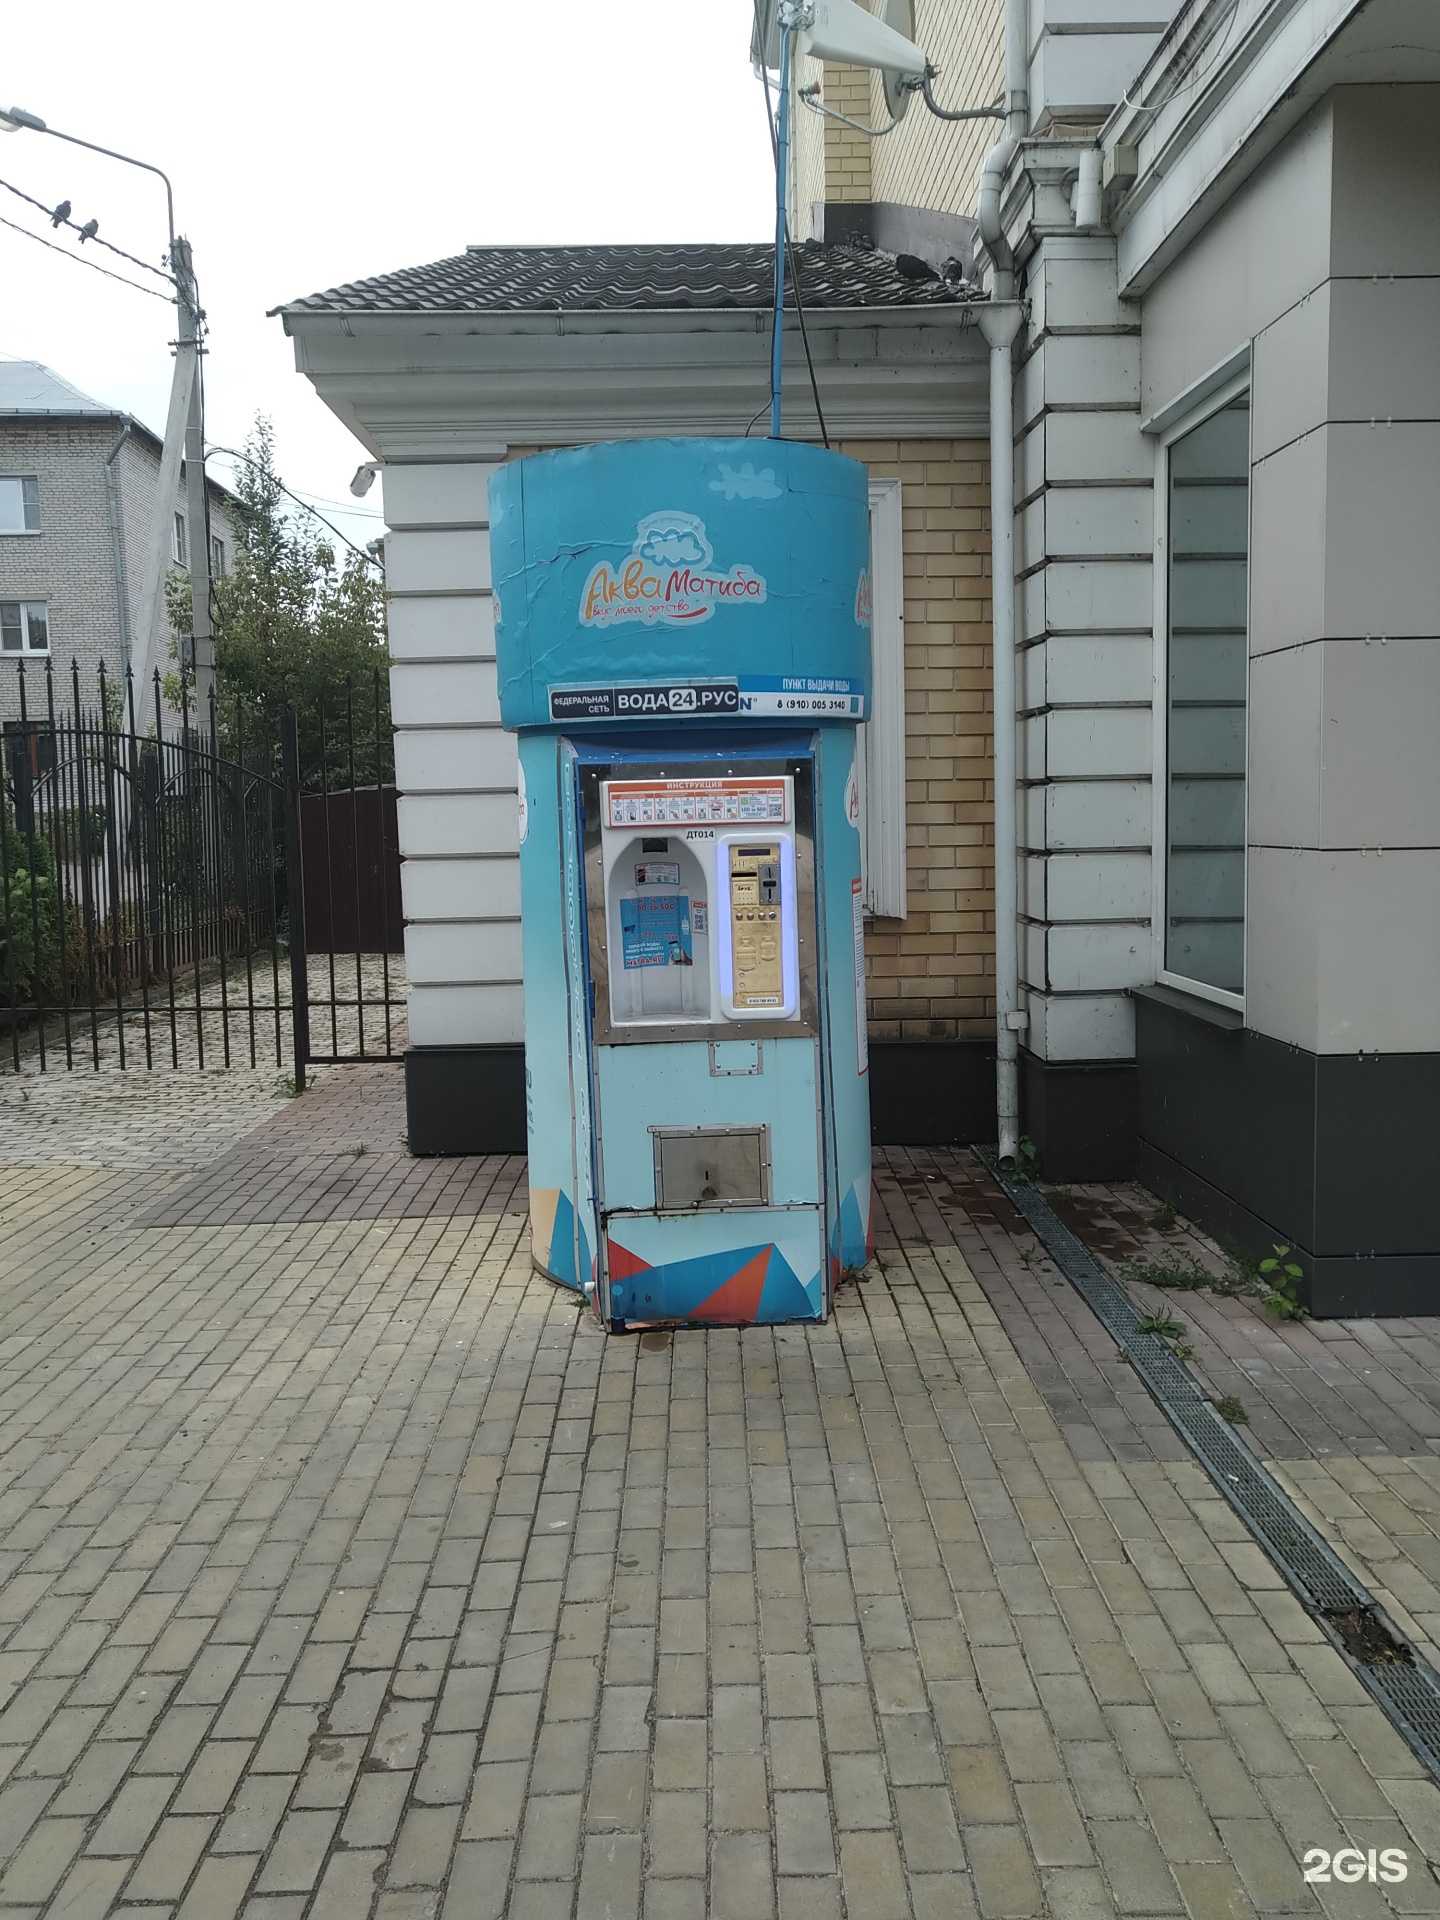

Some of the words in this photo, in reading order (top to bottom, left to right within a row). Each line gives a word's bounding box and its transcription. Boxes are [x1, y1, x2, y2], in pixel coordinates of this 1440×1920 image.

[782, 678, 807, 691] ПУНКТ
[807, 679, 834, 692] ВЫДАЧИ
[554, 695, 610, 706] ФЕДЕРАЛЬНАЯ
[777, 700, 783, 709] 8
[786, 699, 810, 710] (910)
[811, 700, 827, 709] 005
[588, 705, 610, 714] СЕТЬ
[666, 780, 723, 790] ИНСТРУКЦИЯ
